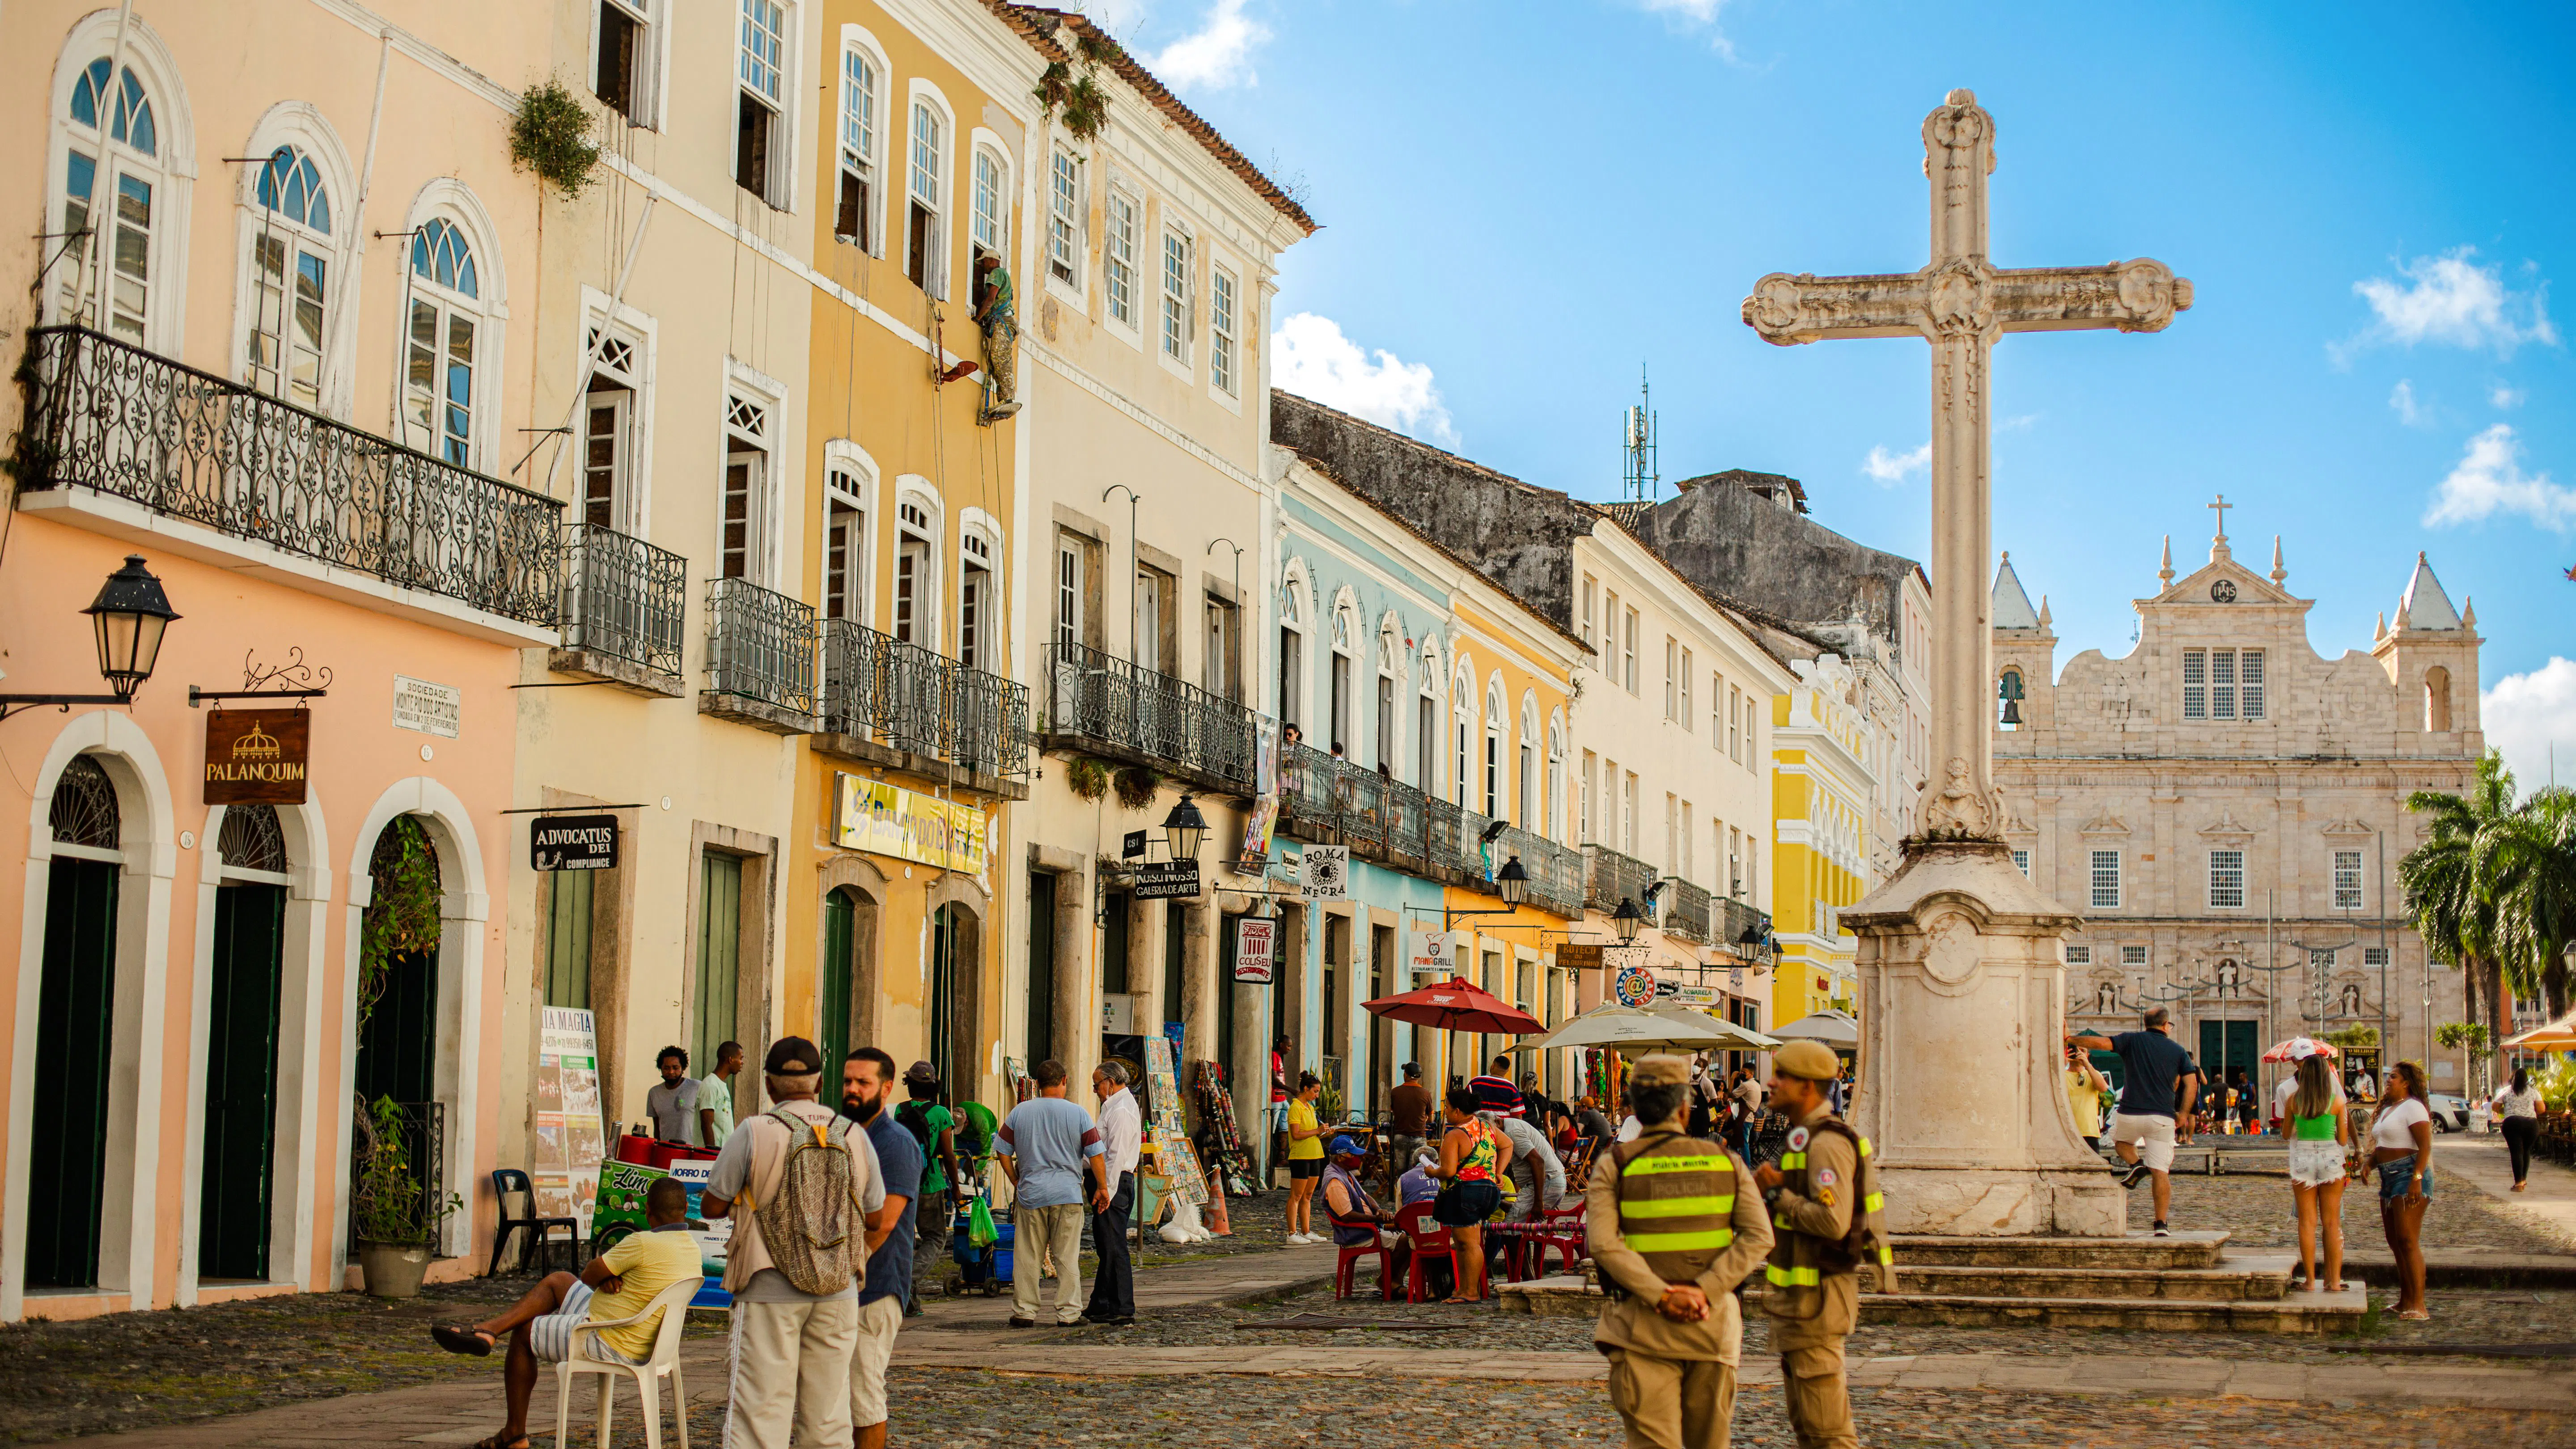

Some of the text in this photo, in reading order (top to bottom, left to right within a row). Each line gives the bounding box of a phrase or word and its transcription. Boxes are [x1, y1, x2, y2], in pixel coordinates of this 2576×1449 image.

[407, 683, 448, 699] SOCIEDADE
[396, 691, 414, 711] MONTE
[424, 698, 433, 715] DOS
[434, 700, 457, 721] ARTISTAS
[395, 710, 457, 731] FUNDADA EM 2 DE FEVEREIRO DE
[207, 762, 304, 783] PALANQUIM
[536, 827, 611, 845] ADVOCATUS
[918, 818, 934, 848] DO
[589, 843, 610, 854] DEI
[1304, 848, 1345, 864] ROMA
[566, 858, 610, 869] COMPLIANCE
[1136, 883, 1198, 896] GALERIA DE ARTE
[1301, 884, 1346, 898] NEGRA
[1563, 945, 1596, 955] BOTECO
[1239, 956, 1271, 967] COLISEU
[1559, 959, 1599, 967] PELOURINHO
[1235, 966, 1270, 979] RESTAURANTE
[558, 1011, 591, 1032] MAGIA
[670, 1168, 699, 1178] MORRO
